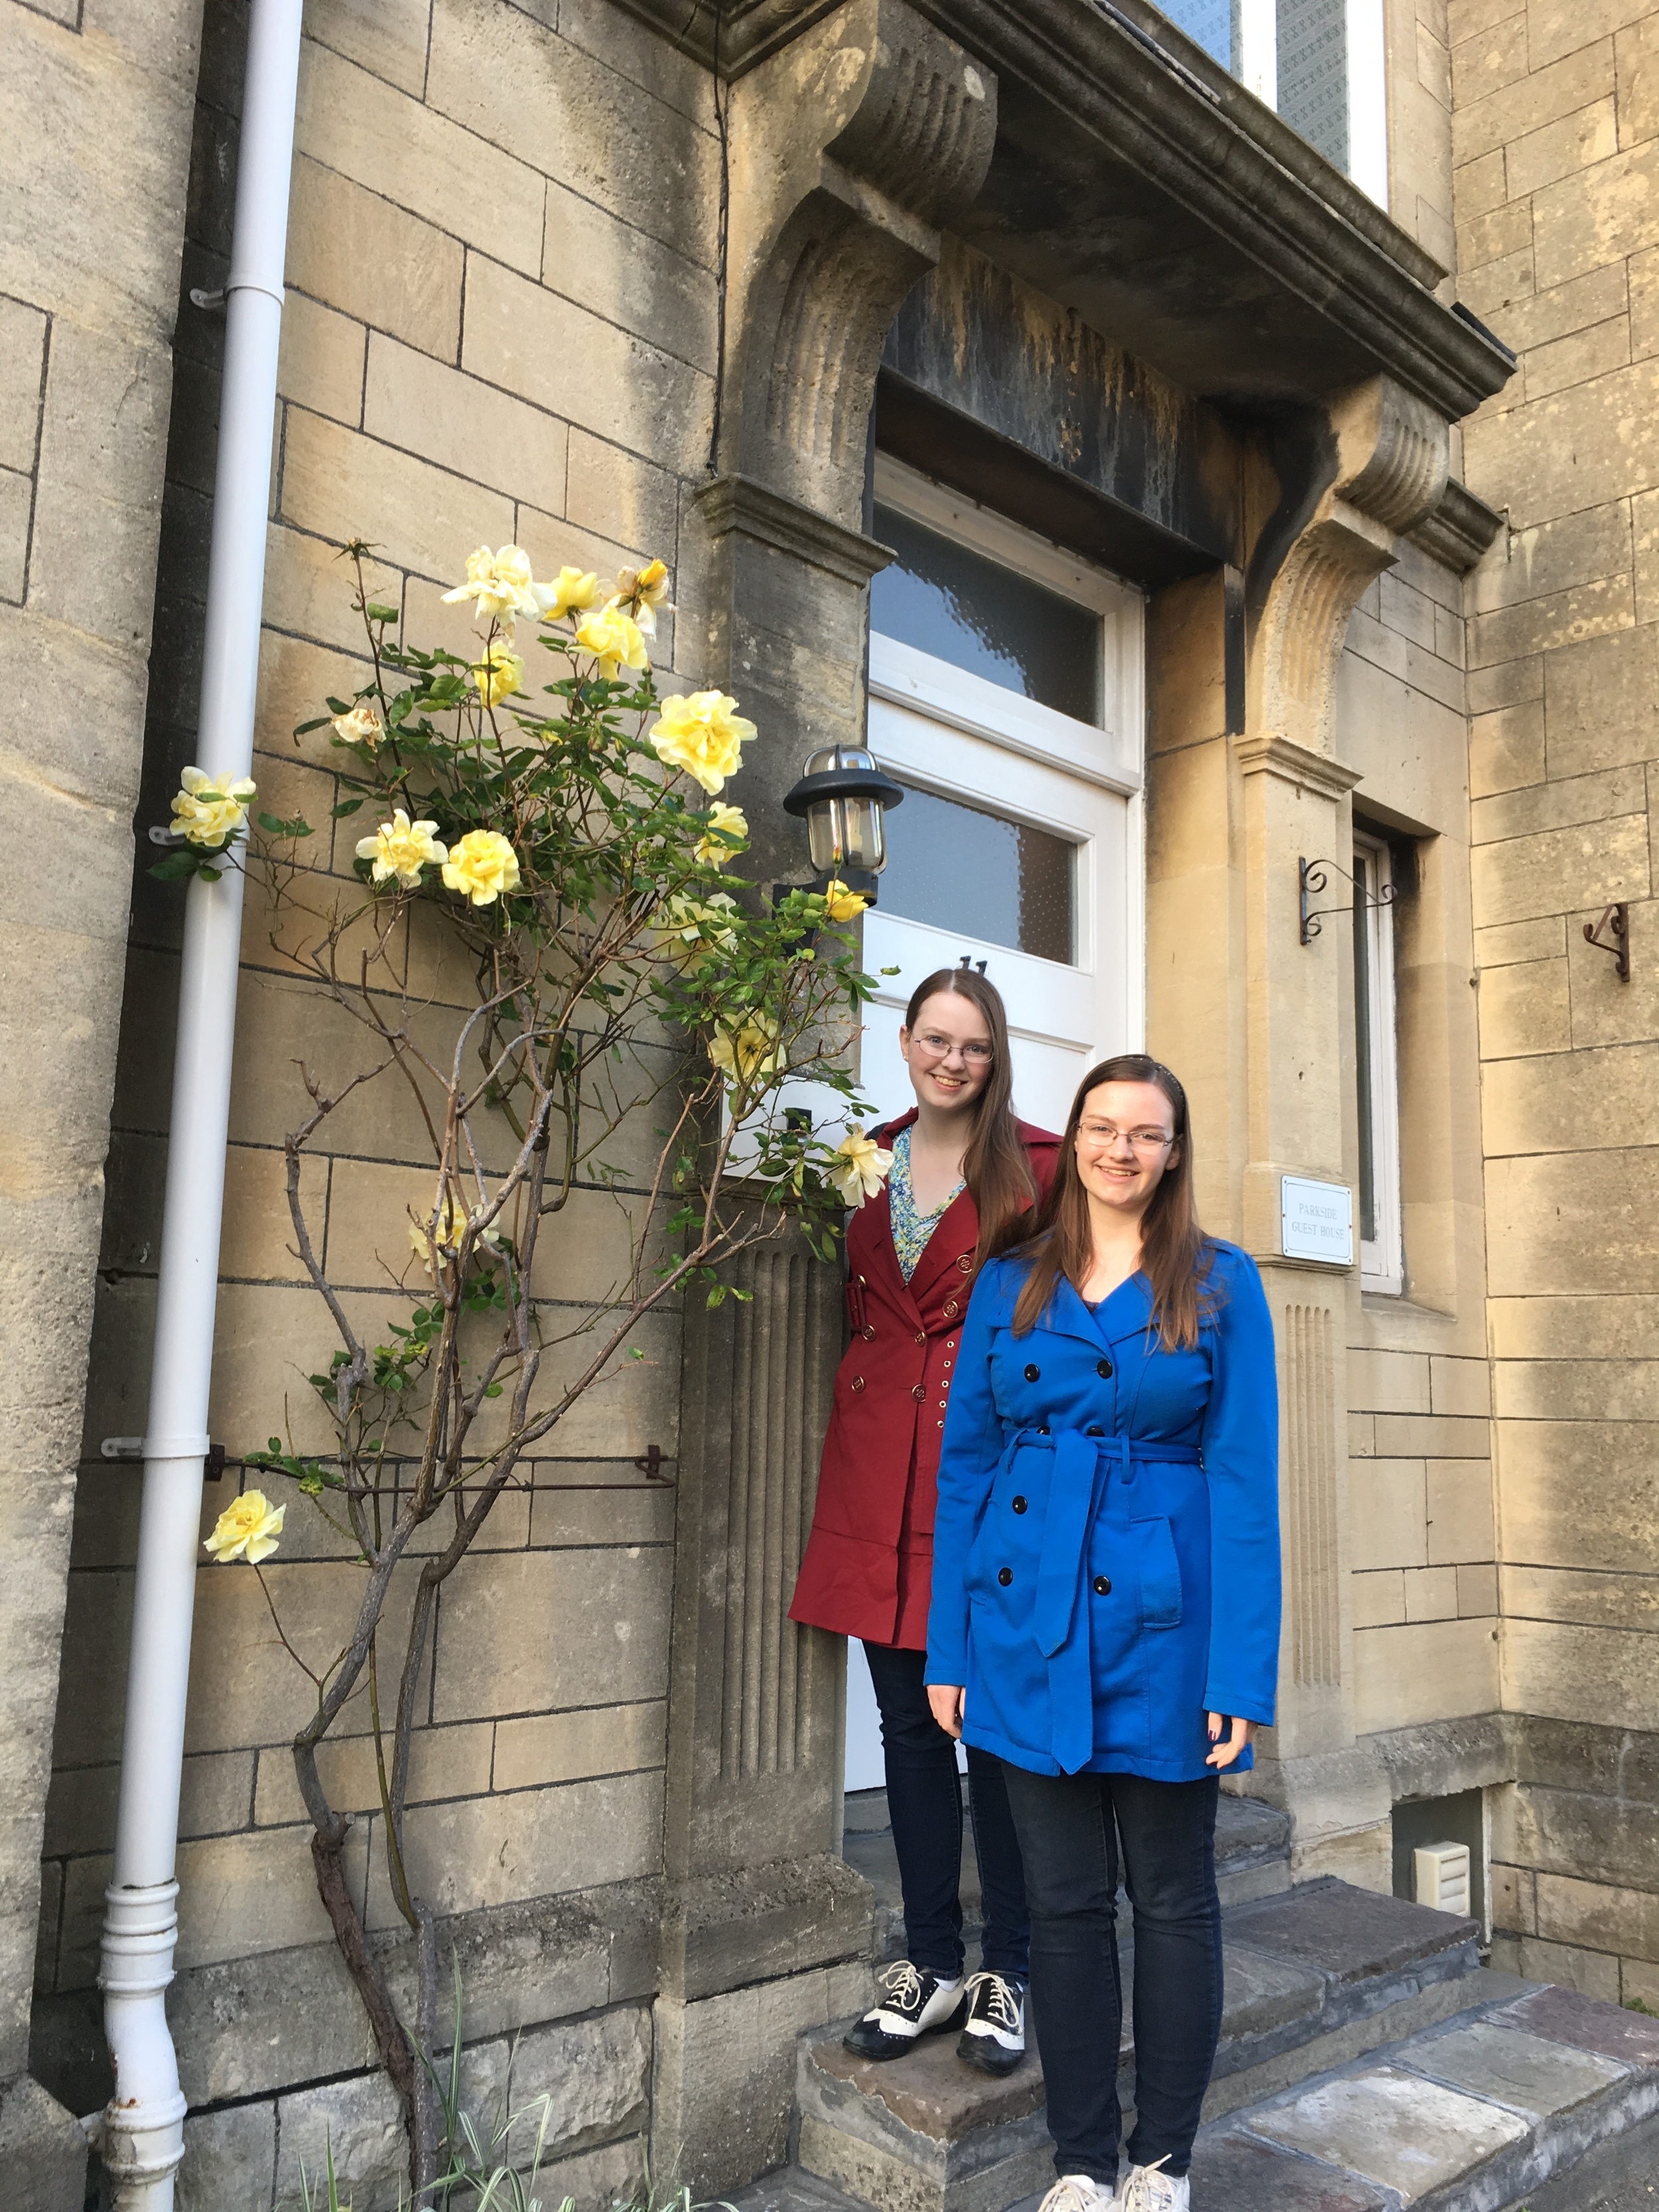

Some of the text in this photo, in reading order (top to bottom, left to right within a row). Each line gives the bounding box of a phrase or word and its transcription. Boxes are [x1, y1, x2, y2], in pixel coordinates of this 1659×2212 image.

[1299, 1203, 1338, 1220] PARKSIDE
[1291, 1221, 1344, 1240] GUEST HOUSE
